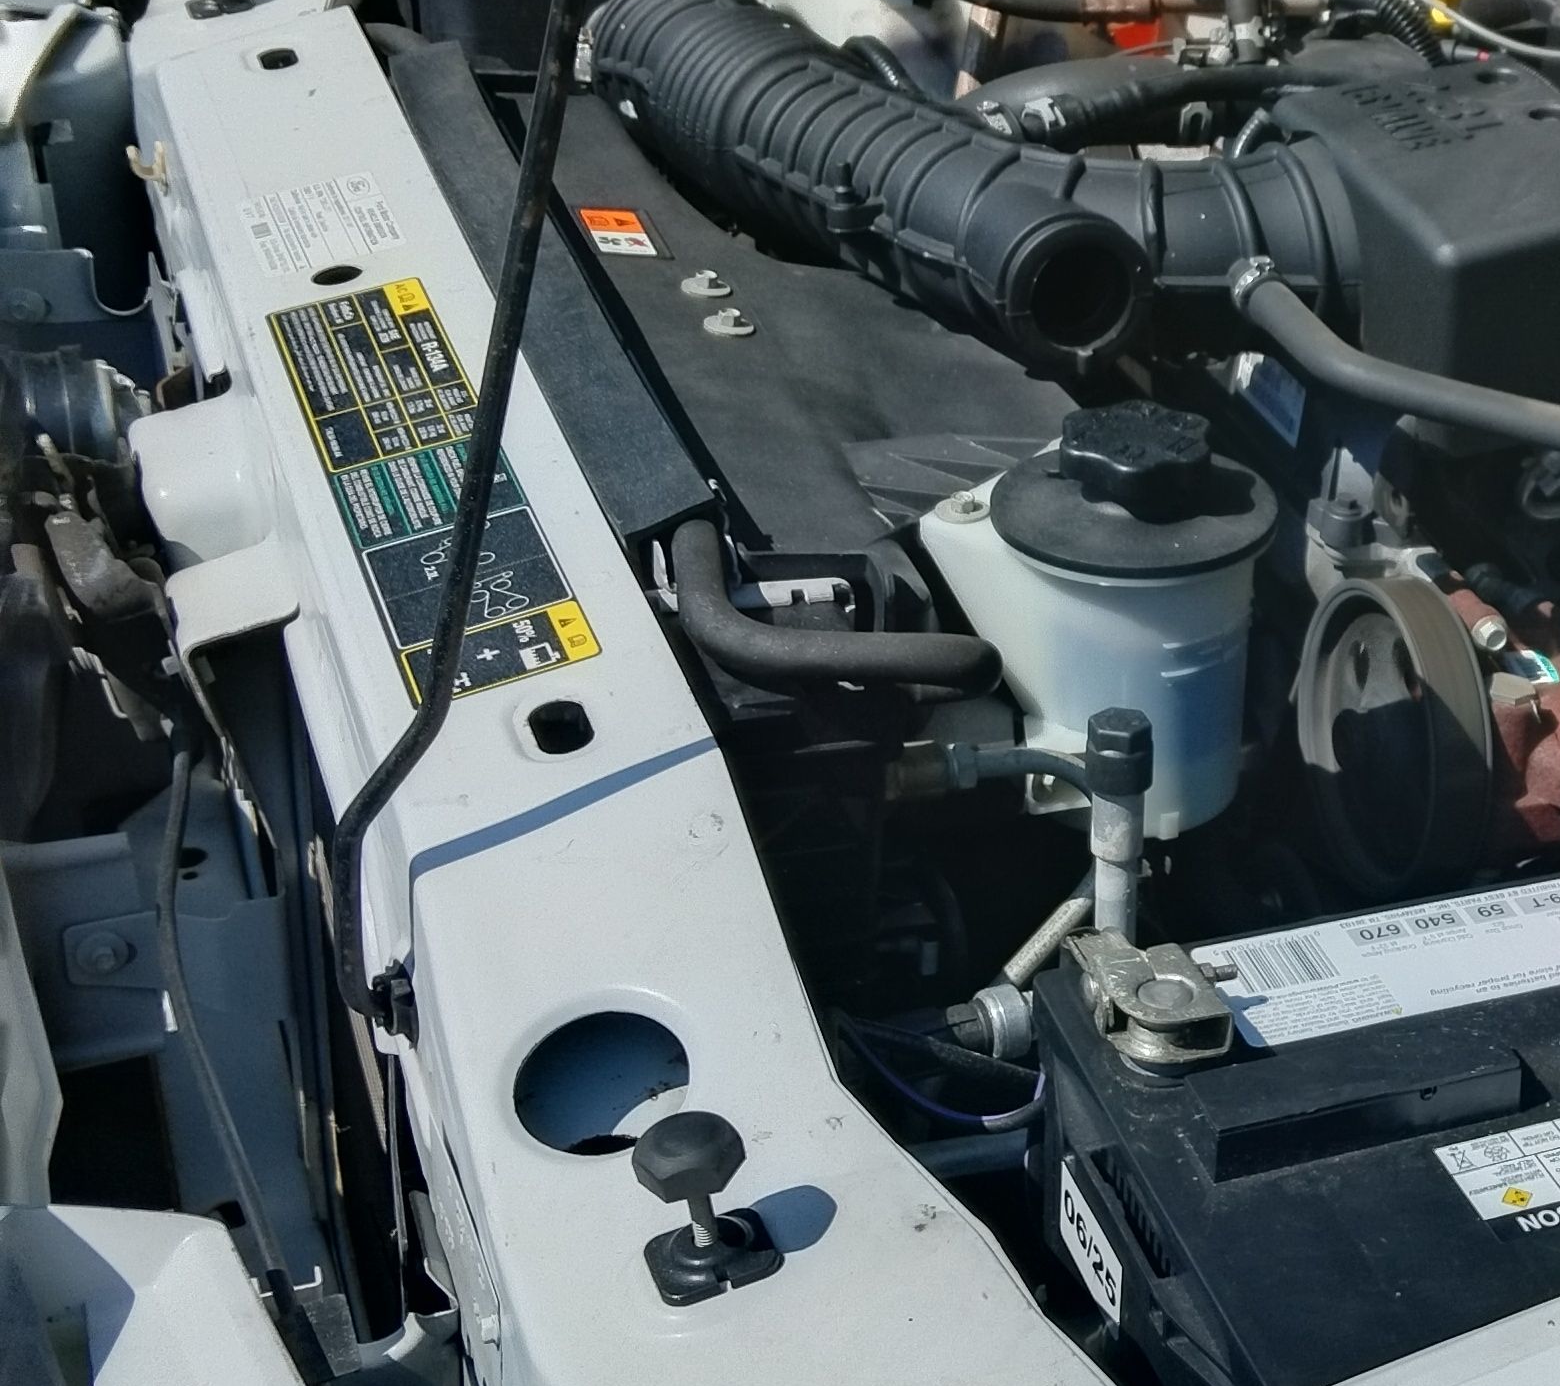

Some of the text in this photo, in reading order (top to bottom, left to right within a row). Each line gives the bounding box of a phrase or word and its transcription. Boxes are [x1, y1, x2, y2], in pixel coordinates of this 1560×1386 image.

[512, 619, 537, 643] 50%
[1477, 903, 1505, 918] 59
[1414, 913, 1456, 930] 540
[1359, 923, 1401, 941] 670
[1065, 1189, 1114, 1306] 06/25
